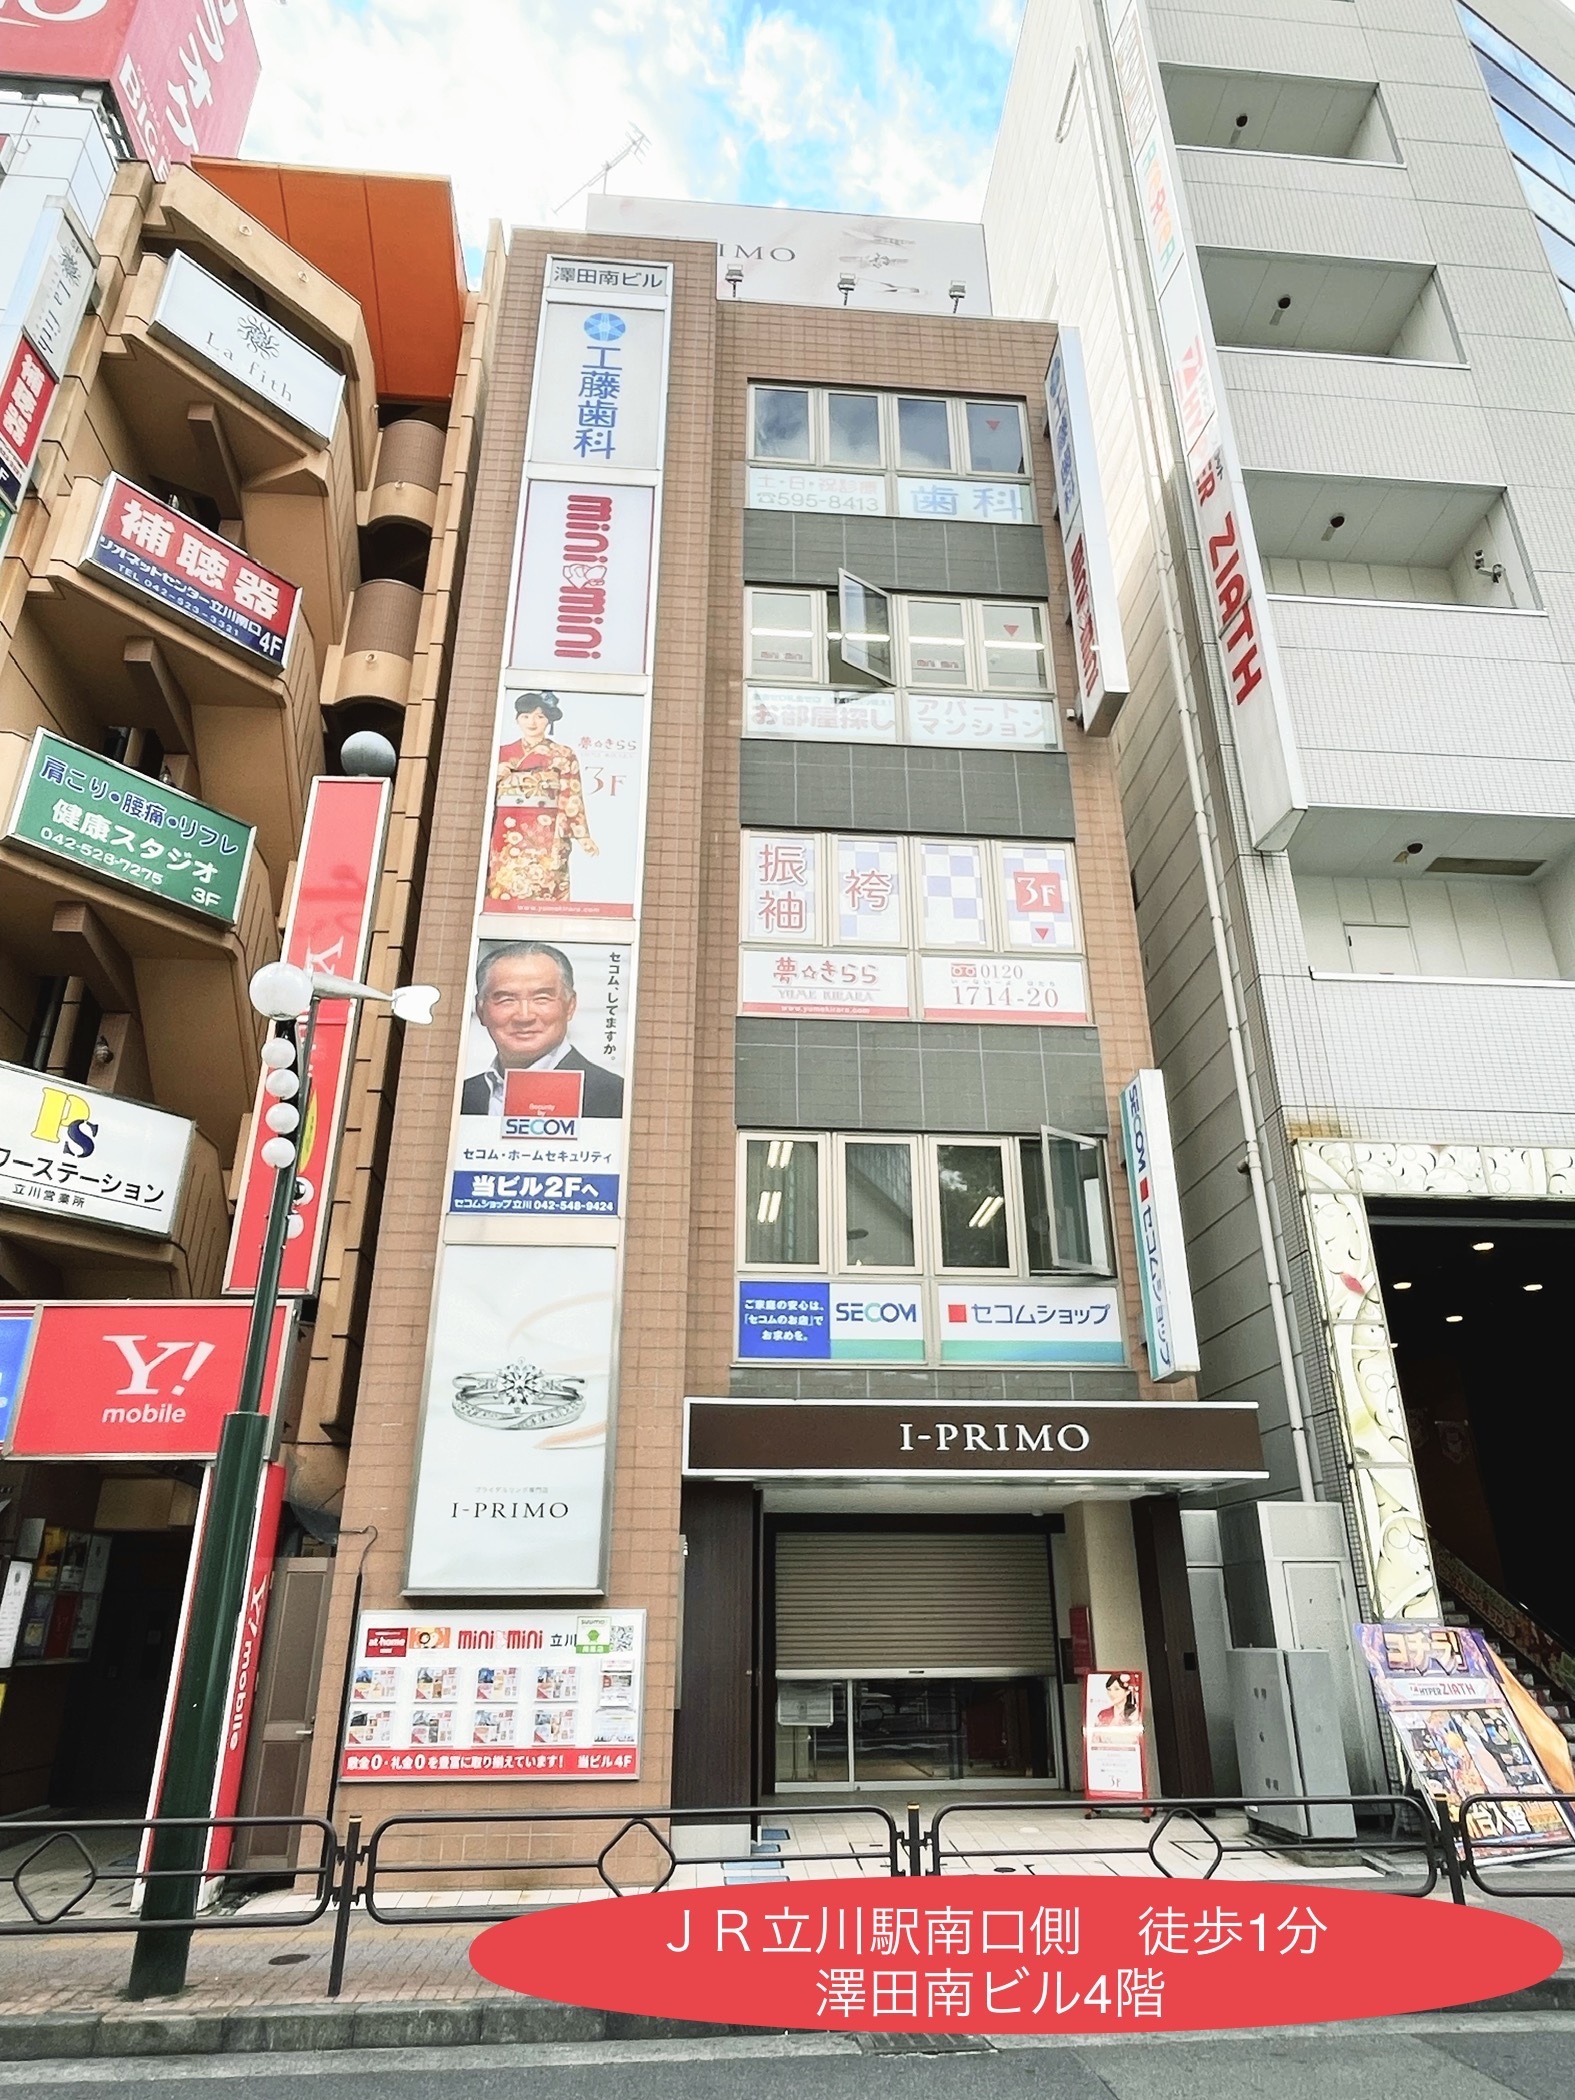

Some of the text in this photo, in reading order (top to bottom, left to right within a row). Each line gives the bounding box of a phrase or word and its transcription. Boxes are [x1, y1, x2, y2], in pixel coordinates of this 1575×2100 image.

[553, 265, 664, 289] 澤田南ビル
[206, 331, 292, 402] La fith
[573, 346, 623, 460] 工藤歯科
[777, 491, 880, 512] 595-8413
[911, 485, 1024, 521] 歯科
[118, 562, 141, 582] TEL
[120, 499, 280, 621] 補聴器
[1207, 510, 1263, 706] ZIATH
[259, 631, 284, 657] 4F
[752, 703, 897, 732] お部屋探し
[584, 766, 628, 797] 3F
[51, 798, 219, 884] 健康スタジオ
[40, 826, 164, 886] 042-528-7275
[190, 886, 223, 908] 3F
[759, 843, 808, 933] 振袖
[844, 869, 893, 912] 袴
[1016, 875, 1058, 908] 3F
[980, 963, 1024, 980] 0120
[603, 951, 622, 1061] セコム、してますか。
[952, 985, 1060, 1009] 1714-20
[31, 1087, 99, 1158] PS
[505, 1118, 575, 1136] SECOM
[1127, 1083, 1148, 1174] SECOM
[463, 1147, 613, 1164] セコム・ホームセキュリティ
[12, 1183, 86, 1210] 立川営業所
[471, 1174, 600, 1200] 当ビル2Fへ
[454, 1198, 532, 1211] セコムショップ立川
[1140, 1205, 1172, 1369] セコムショップ
[835, 1302, 918, 1323] SECOM
[970, 1302, 1112, 1325] セコムショップ
[103, 1335, 216, 1397] Y!
[101, 1403, 188, 1425] mobile
[900, 1423, 1091, 1453] I-PRIMO
[451, 1501, 570, 1520] I-PRIMO
[458, 1629, 495, 1650] mini
[506, 1629, 544, 1650] mini
[229, 1640, 253, 1752] mobile
[1440, 1682, 1477, 1697] ZIATH
[577, 1754, 633, 1770] 当ビル4F
